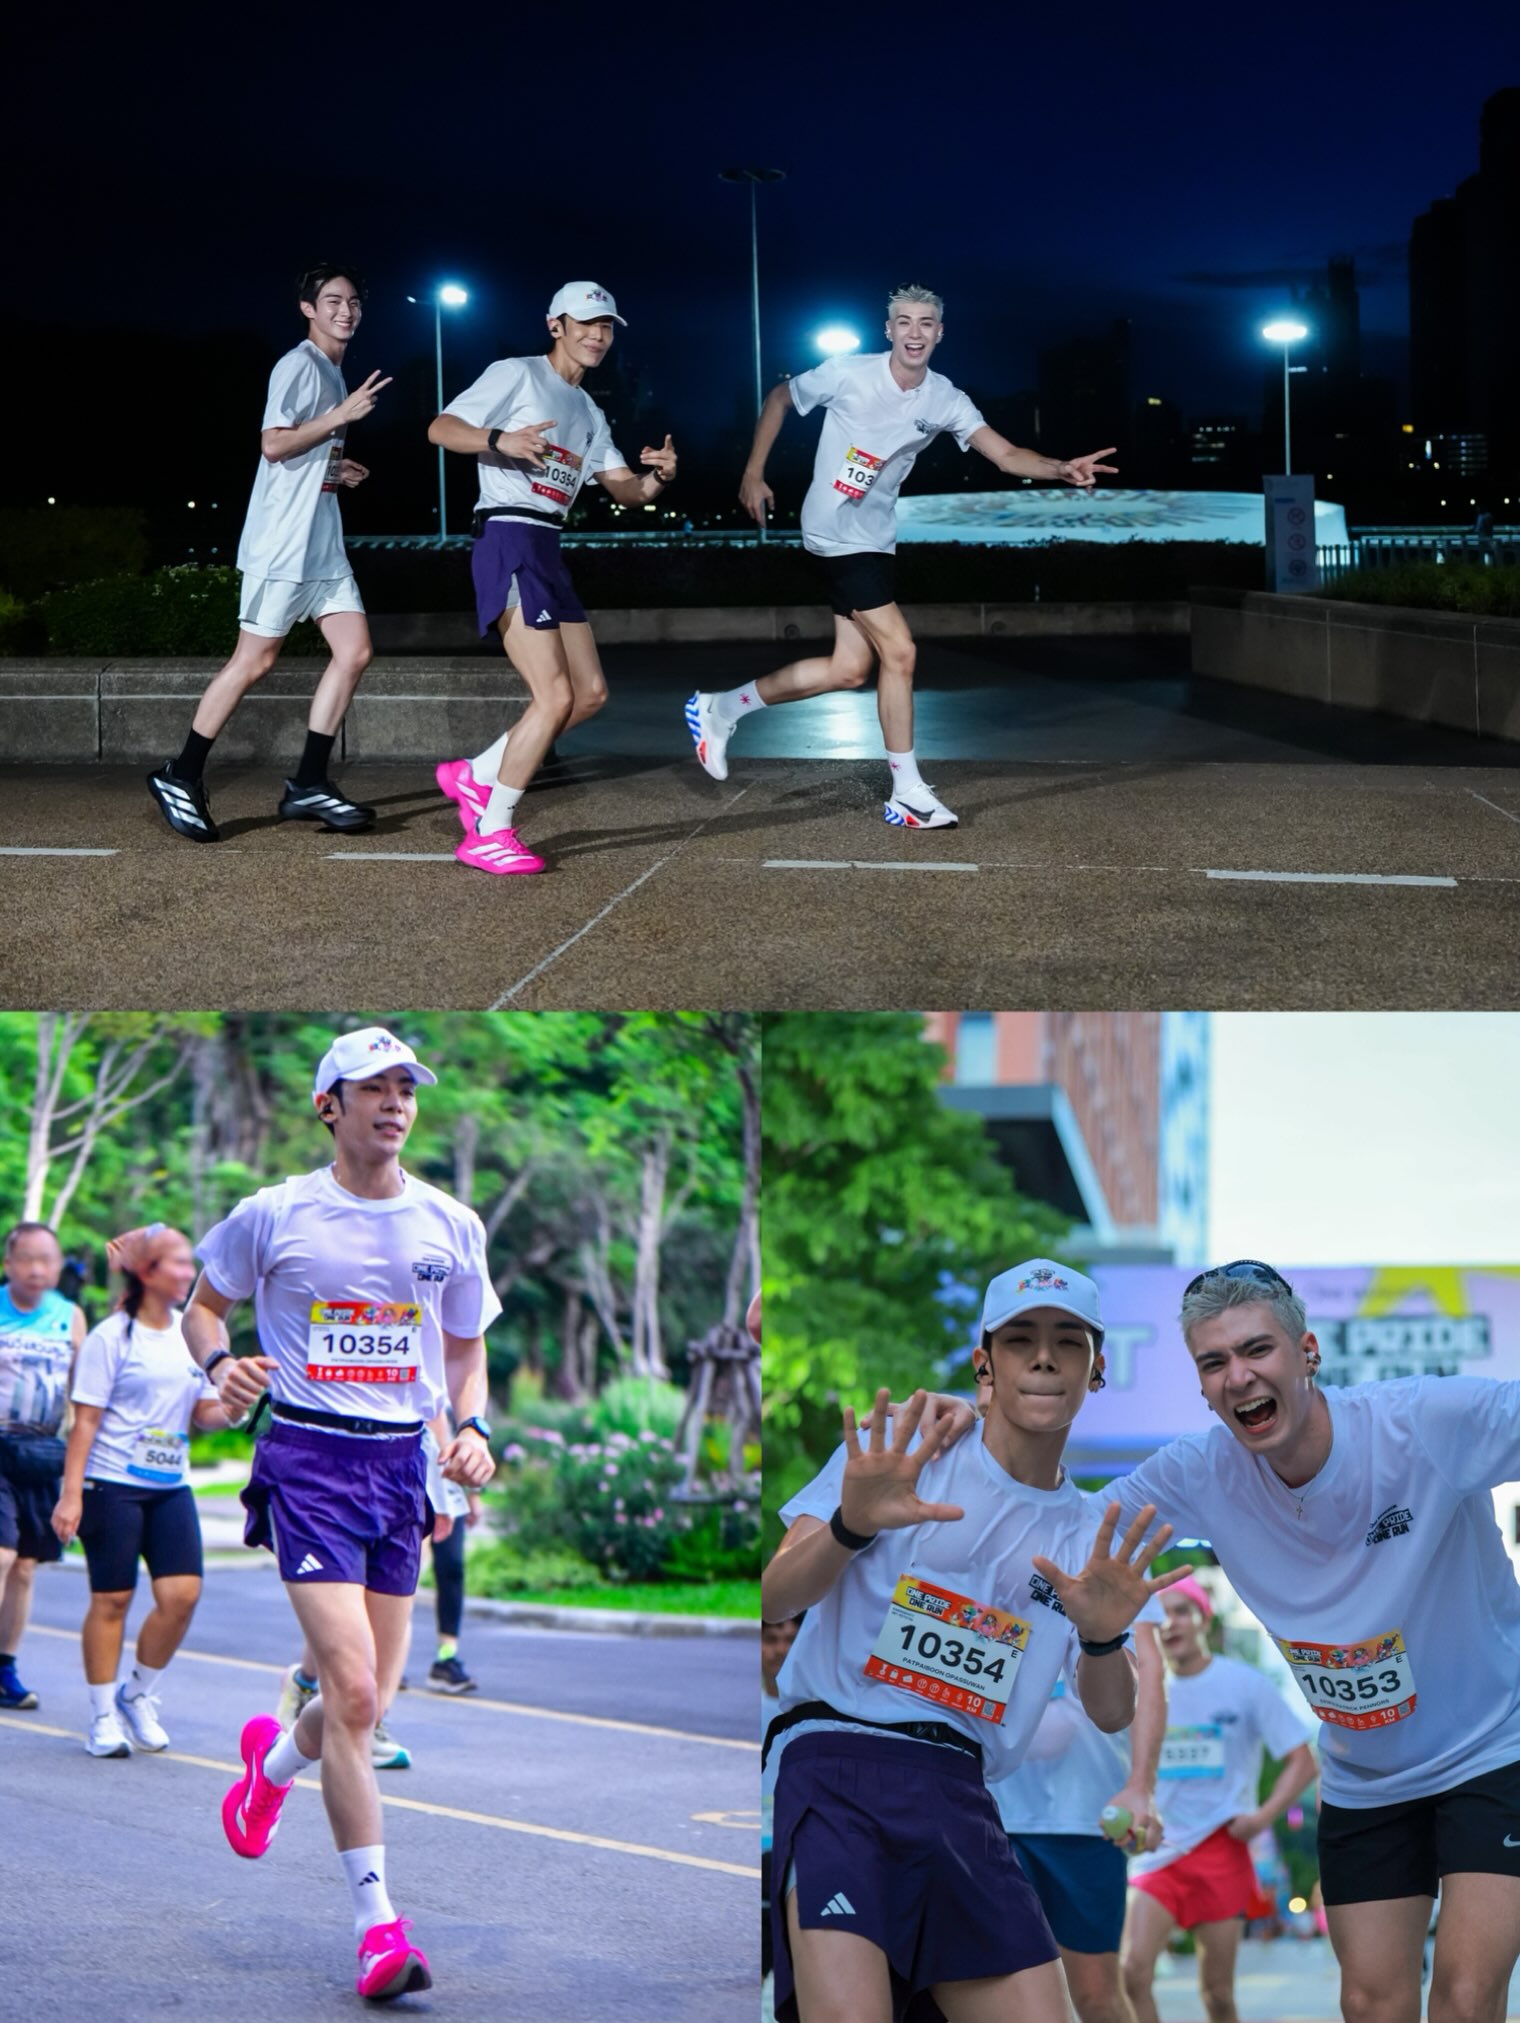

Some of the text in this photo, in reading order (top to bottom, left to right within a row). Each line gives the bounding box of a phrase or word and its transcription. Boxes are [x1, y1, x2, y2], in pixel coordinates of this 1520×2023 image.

[544, 465, 577, 488] 10354
[323, 1333, 410, 1355] 10354
[906, 1586, 924, 1599] ONE
[1031, 1575, 1052, 1595] ONE
[909, 1597, 926, 1609] ONE
[926, 1604, 943, 1615] RUN
[900, 1624, 1006, 1684] 10354
[1010, 1649, 1019, 1659] E
[1395, 1654, 1403, 1664] E
[1302, 1669, 1401, 1702] 10353
[967, 1695, 981, 1708] 10
[1380, 1708, 1396, 1719] 10
